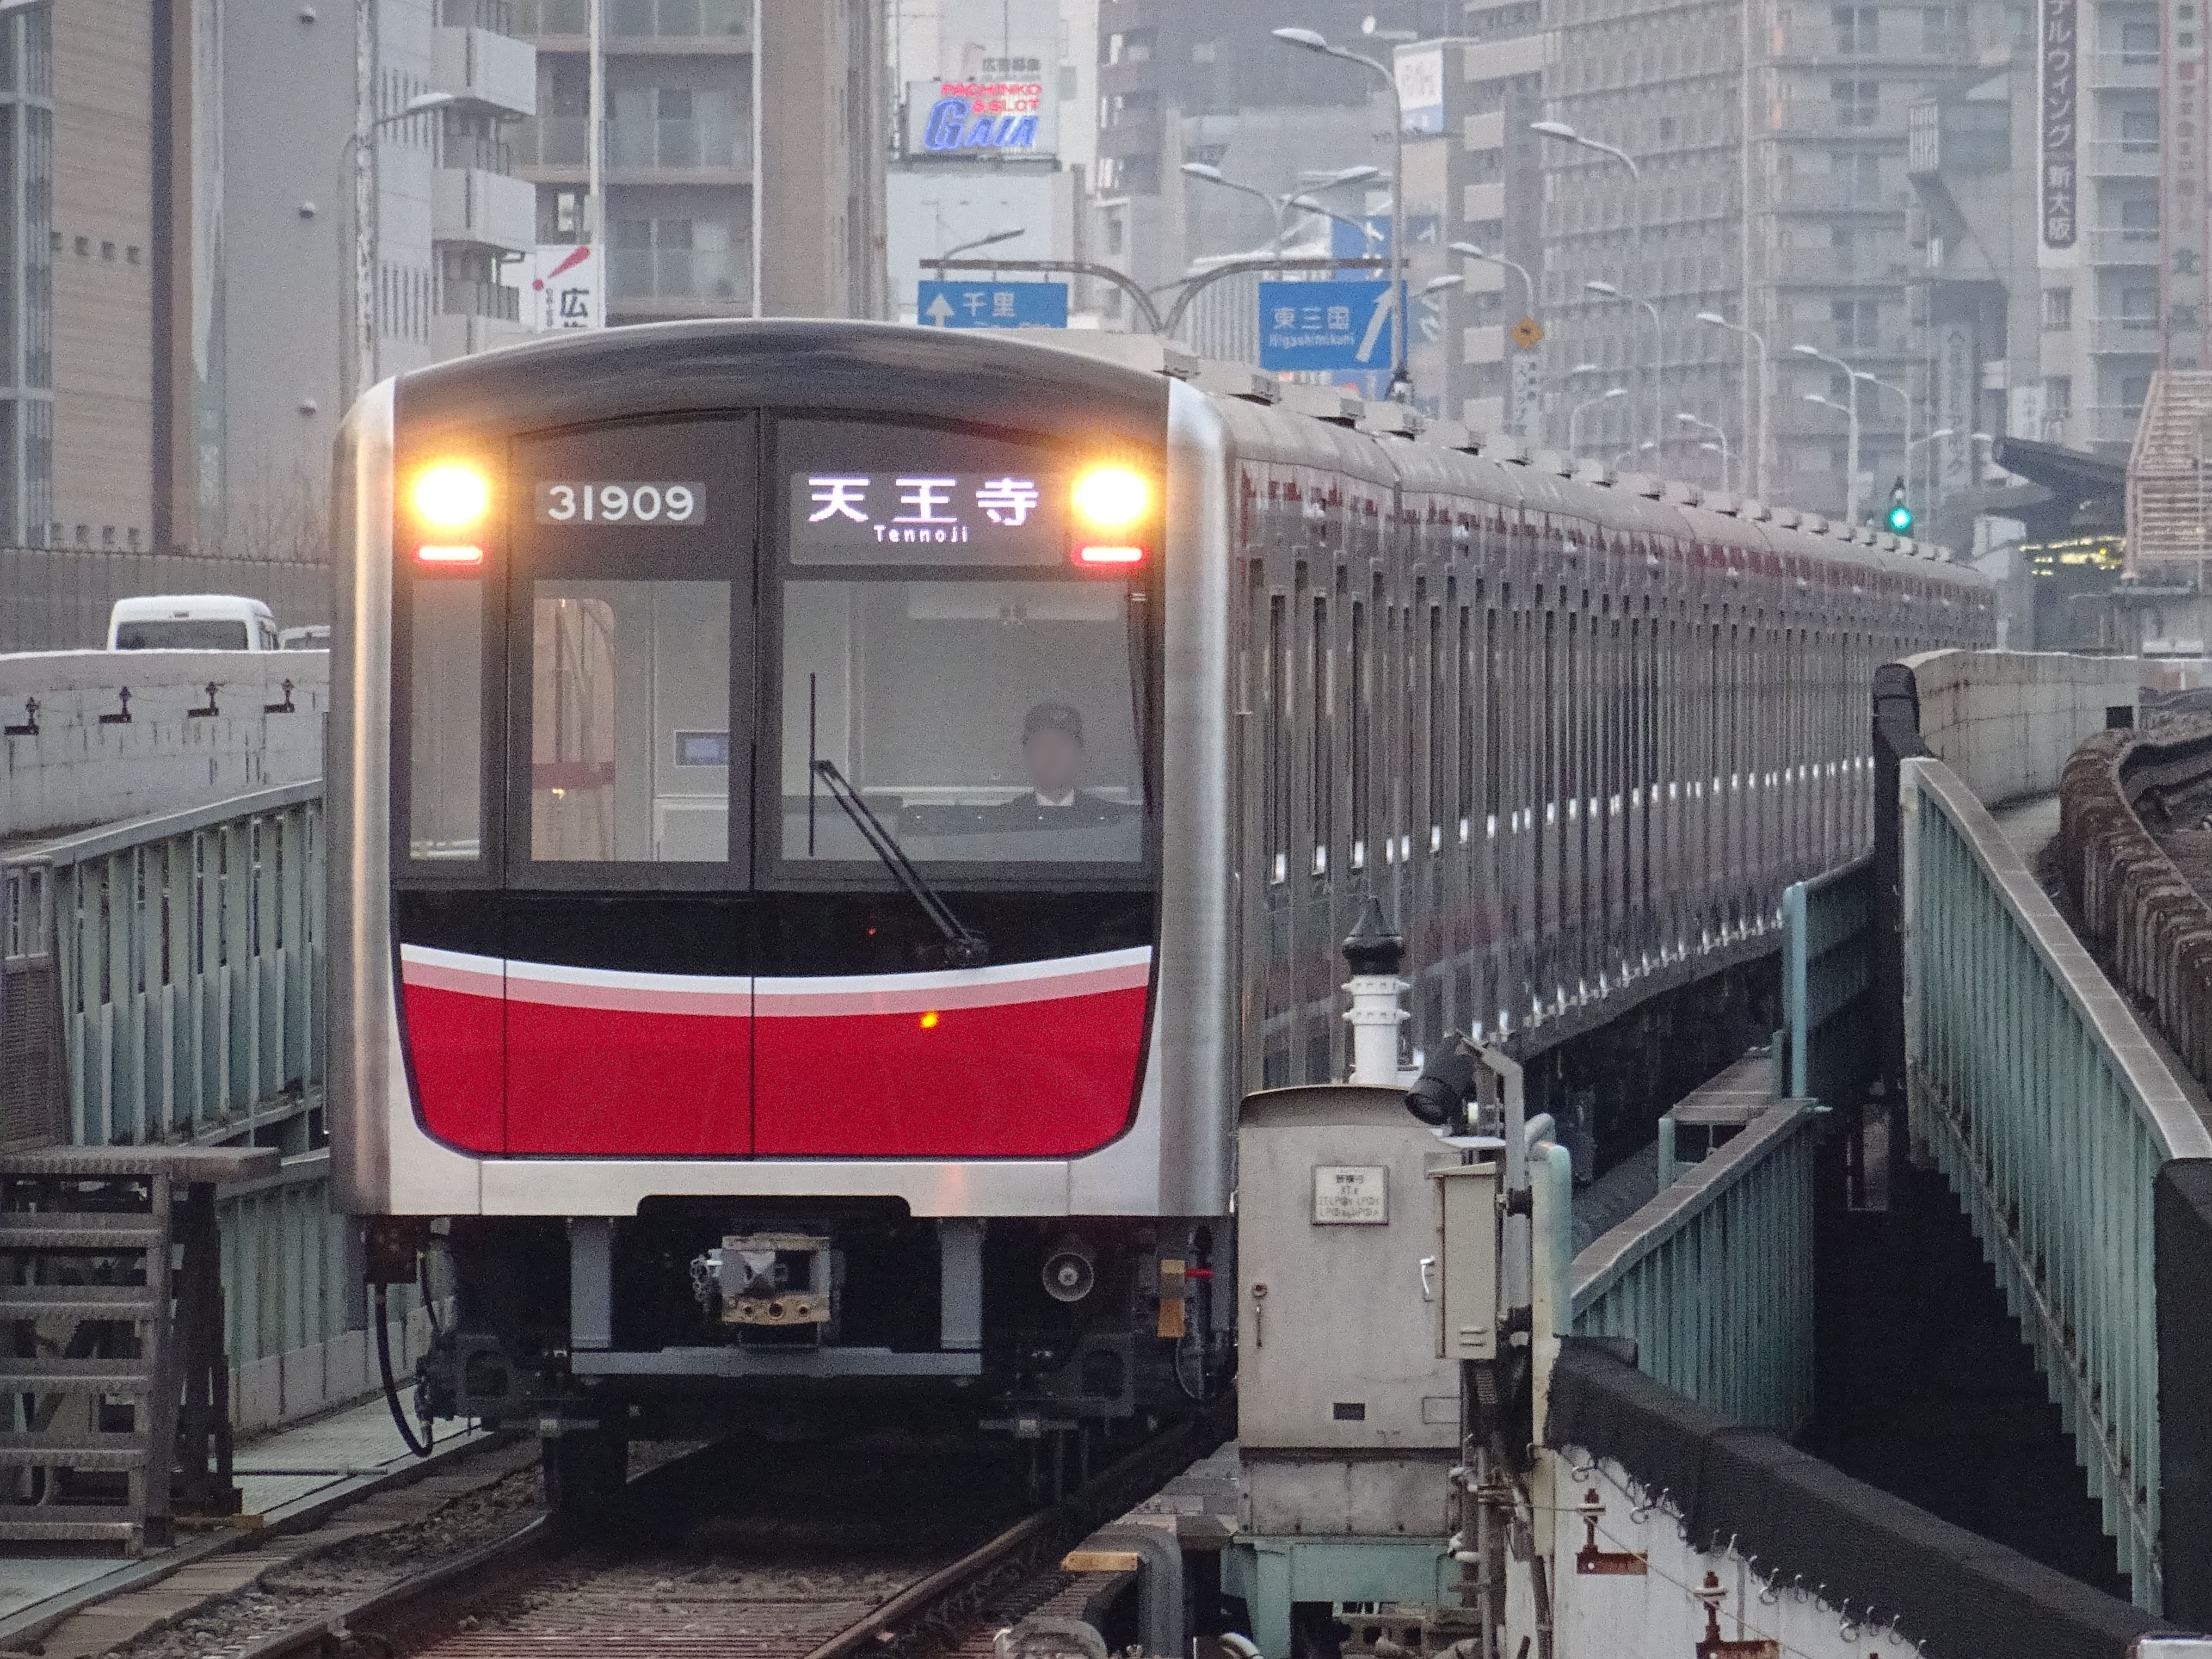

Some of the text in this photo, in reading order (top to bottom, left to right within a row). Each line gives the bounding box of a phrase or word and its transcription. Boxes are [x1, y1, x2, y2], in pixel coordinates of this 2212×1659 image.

[941, 83, 1042, 97] PACHINKO
[989, 99, 1040, 113] SLOT
[963, 291, 1016, 317] 千里
[1274, 306, 1349, 330] 東三国
[548, 485, 694, 521] 31909
[808, 476, 1039, 526] 天王寺
[873, 524, 969, 543] Tennoji
